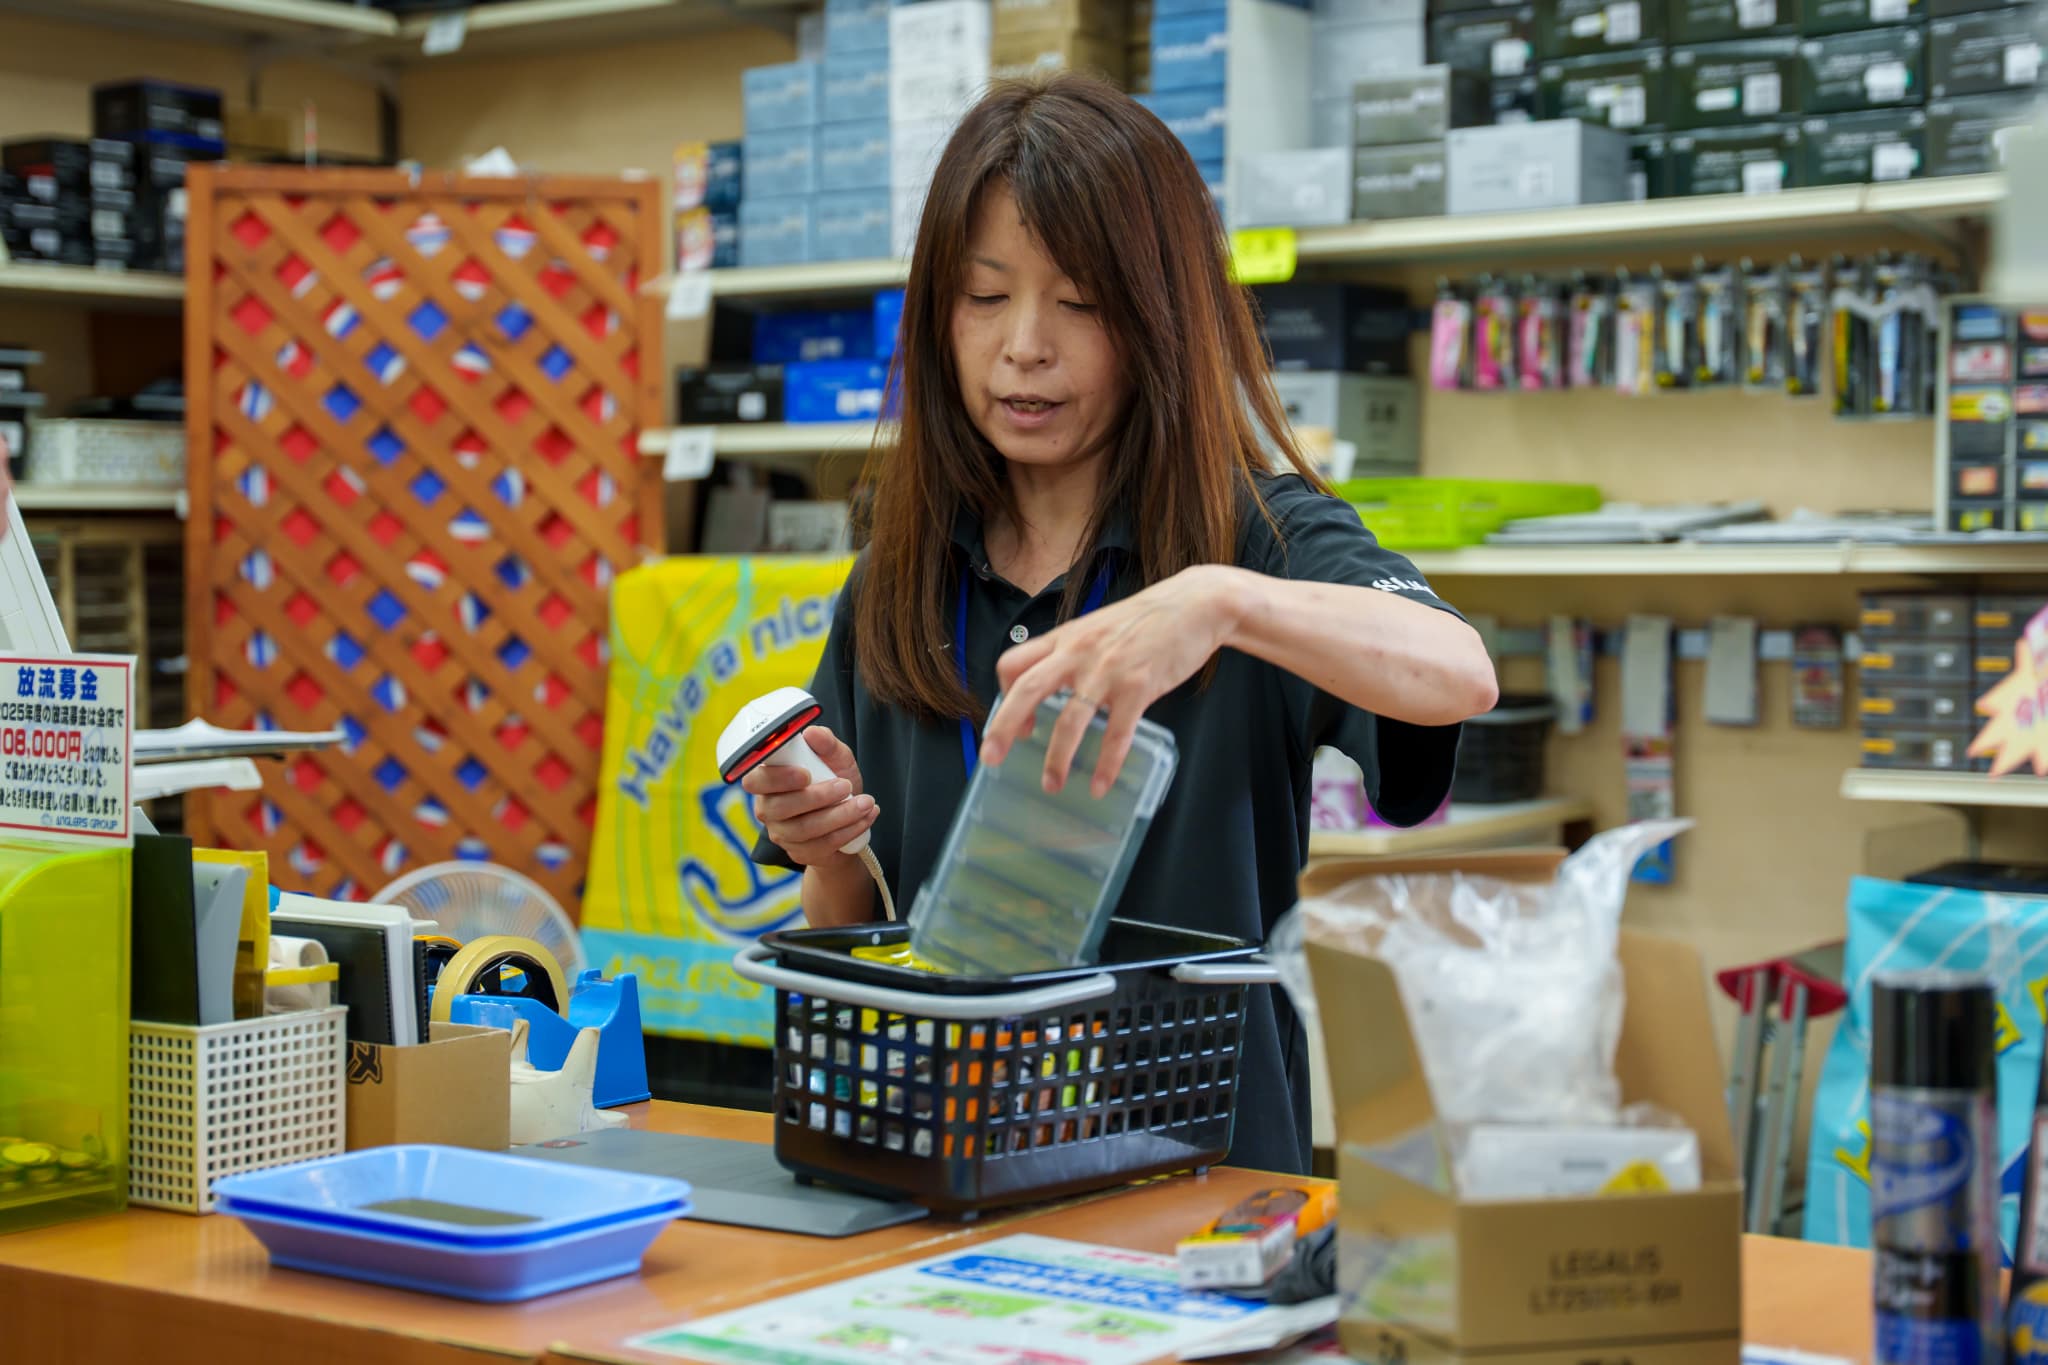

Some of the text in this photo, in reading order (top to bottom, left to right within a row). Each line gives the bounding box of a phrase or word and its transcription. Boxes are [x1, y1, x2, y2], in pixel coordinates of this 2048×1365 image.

[17, 665, 99, 701] 放流募金
[0, 702, 124, 728] 025年度の放流募金は全店で
[619, 673, 702, 806] Have
[712, 640, 737, 680] a
